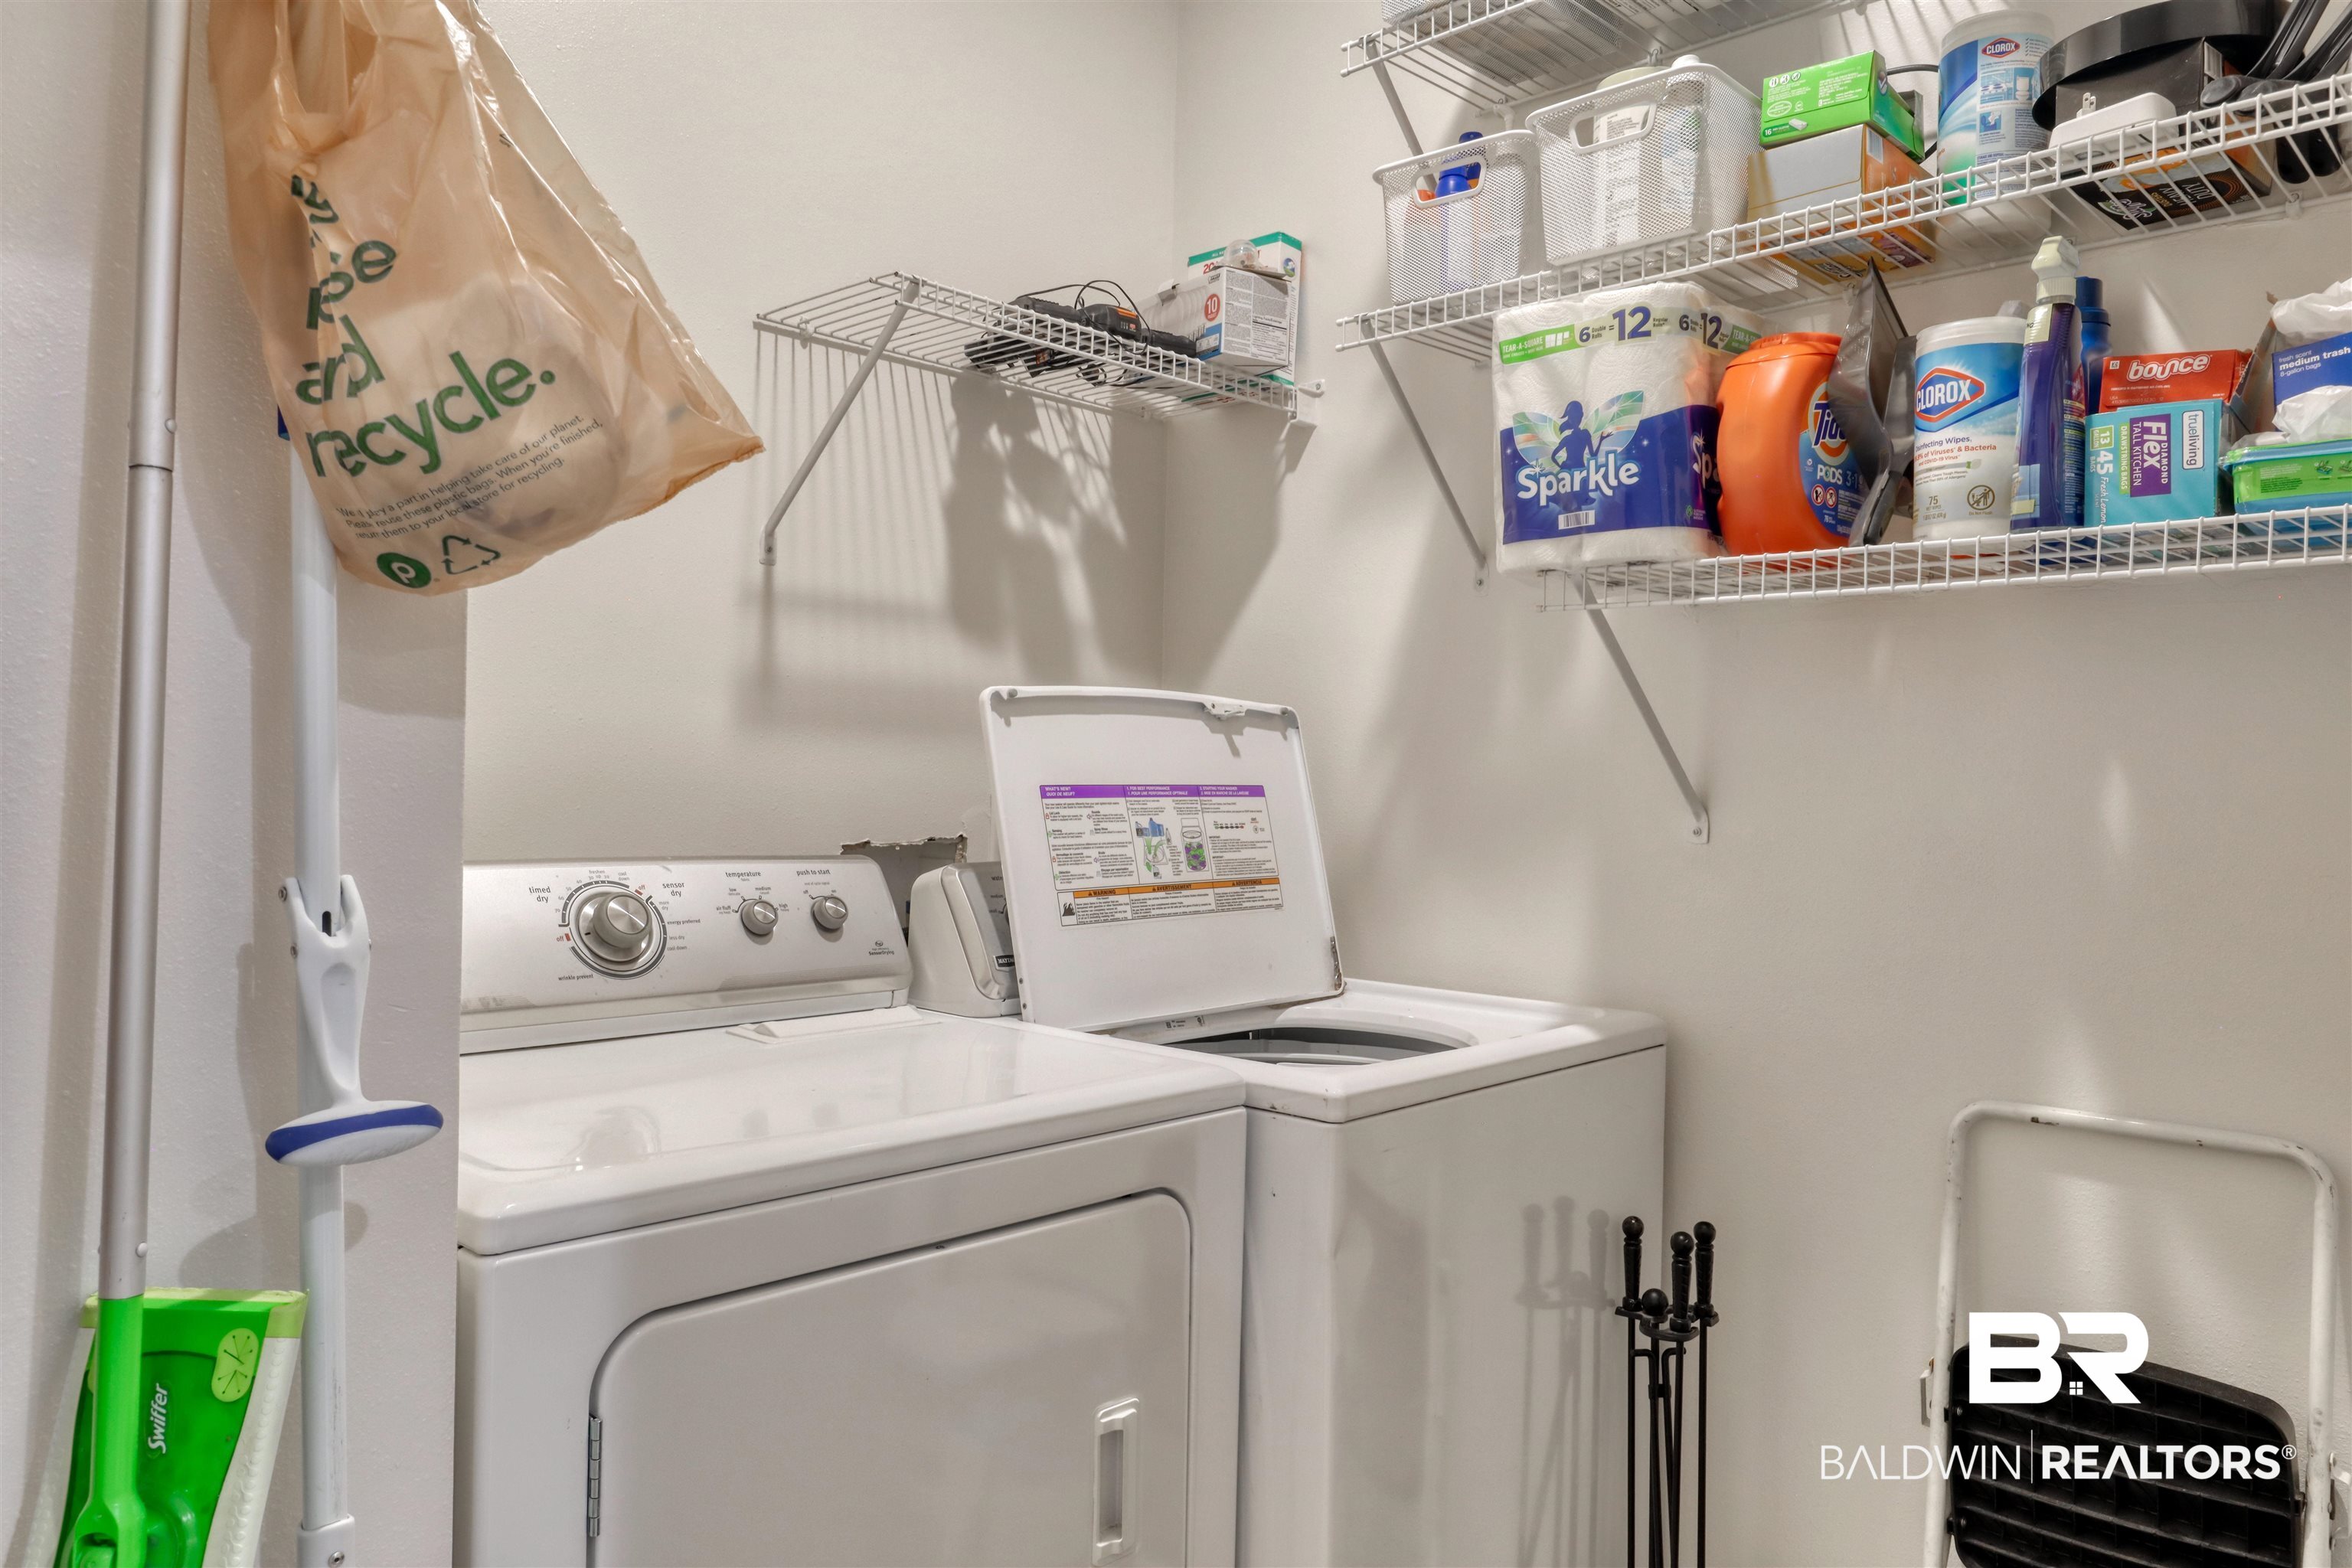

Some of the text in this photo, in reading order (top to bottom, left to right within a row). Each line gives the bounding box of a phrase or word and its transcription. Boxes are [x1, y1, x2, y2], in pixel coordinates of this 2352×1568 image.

[1987, 43, 2015, 54] CLOROX
[1207, 296, 1218, 314] 10
[1579, 327, 1591, 342] 6
[1592, 325, 1606, 334] Double
[1612, 305, 1651, 341] 12
[1679, 314, 1689, 331] 6
[1700, 312, 1722, 349] 12
[1503, 336, 1544, 353] TEAR-A-SQUARE
[2278, 350, 2312, 363] fresh scent
[2279, 346, 2351, 371] medium trash
[2127, 354, 2210, 381] bounce
[2279, 362, 2321, 377] 8-gallon bags
[1916, 379, 1971, 412] CLOROX
[305, 351, 556, 477] recycle.
[2100, 431, 2110, 444] 13
[2143, 421, 2167, 469] Flex
[2186, 413, 2200, 466] trueliving
[388, 504, 395, 512] a
[396, 495, 418, 511] part
[419, 492, 430, 501] in
[429, 473, 471, 498] helping
[470, 462, 494, 479] take
[495, 451, 518, 467] care
[519, 442, 531, 455] of
[532, 433, 547, 449] our
[550, 414, 585, 439] planet.
[2096, 450, 2114, 475] 45
[2132, 422, 2141, 485] TALL KITCHEN
[375, 515, 403, 528] reuse
[403, 506, 432, 520] these
[433, 489, 468, 512] plastic
[466, 478, 497, 495] bags.
[495, 461, 529, 479] When
[529, 443, 560, 466] you're
[560, 418, 603, 446] finished,
[1516, 451, 1640, 507] Sparkle
[1817, 464, 1843, 485] PODS
[381, 525, 409, 538] them
[409, 522, 421, 531] to
[423, 513, 445, 529] your
[447, 501, 472, 518] local
[473, 489, 500, 506] store
[499, 479, 516, 493] for
[517, 457, 565, 485] recycling.
[1929, 495, 1938, 505] 75
[2100, 476, 2109, 523] Fresh Lemon
[529, 886, 550, 894] timed
[537, 894, 549, 903] dry
[148, 1383, 169, 1455] Swiffer
